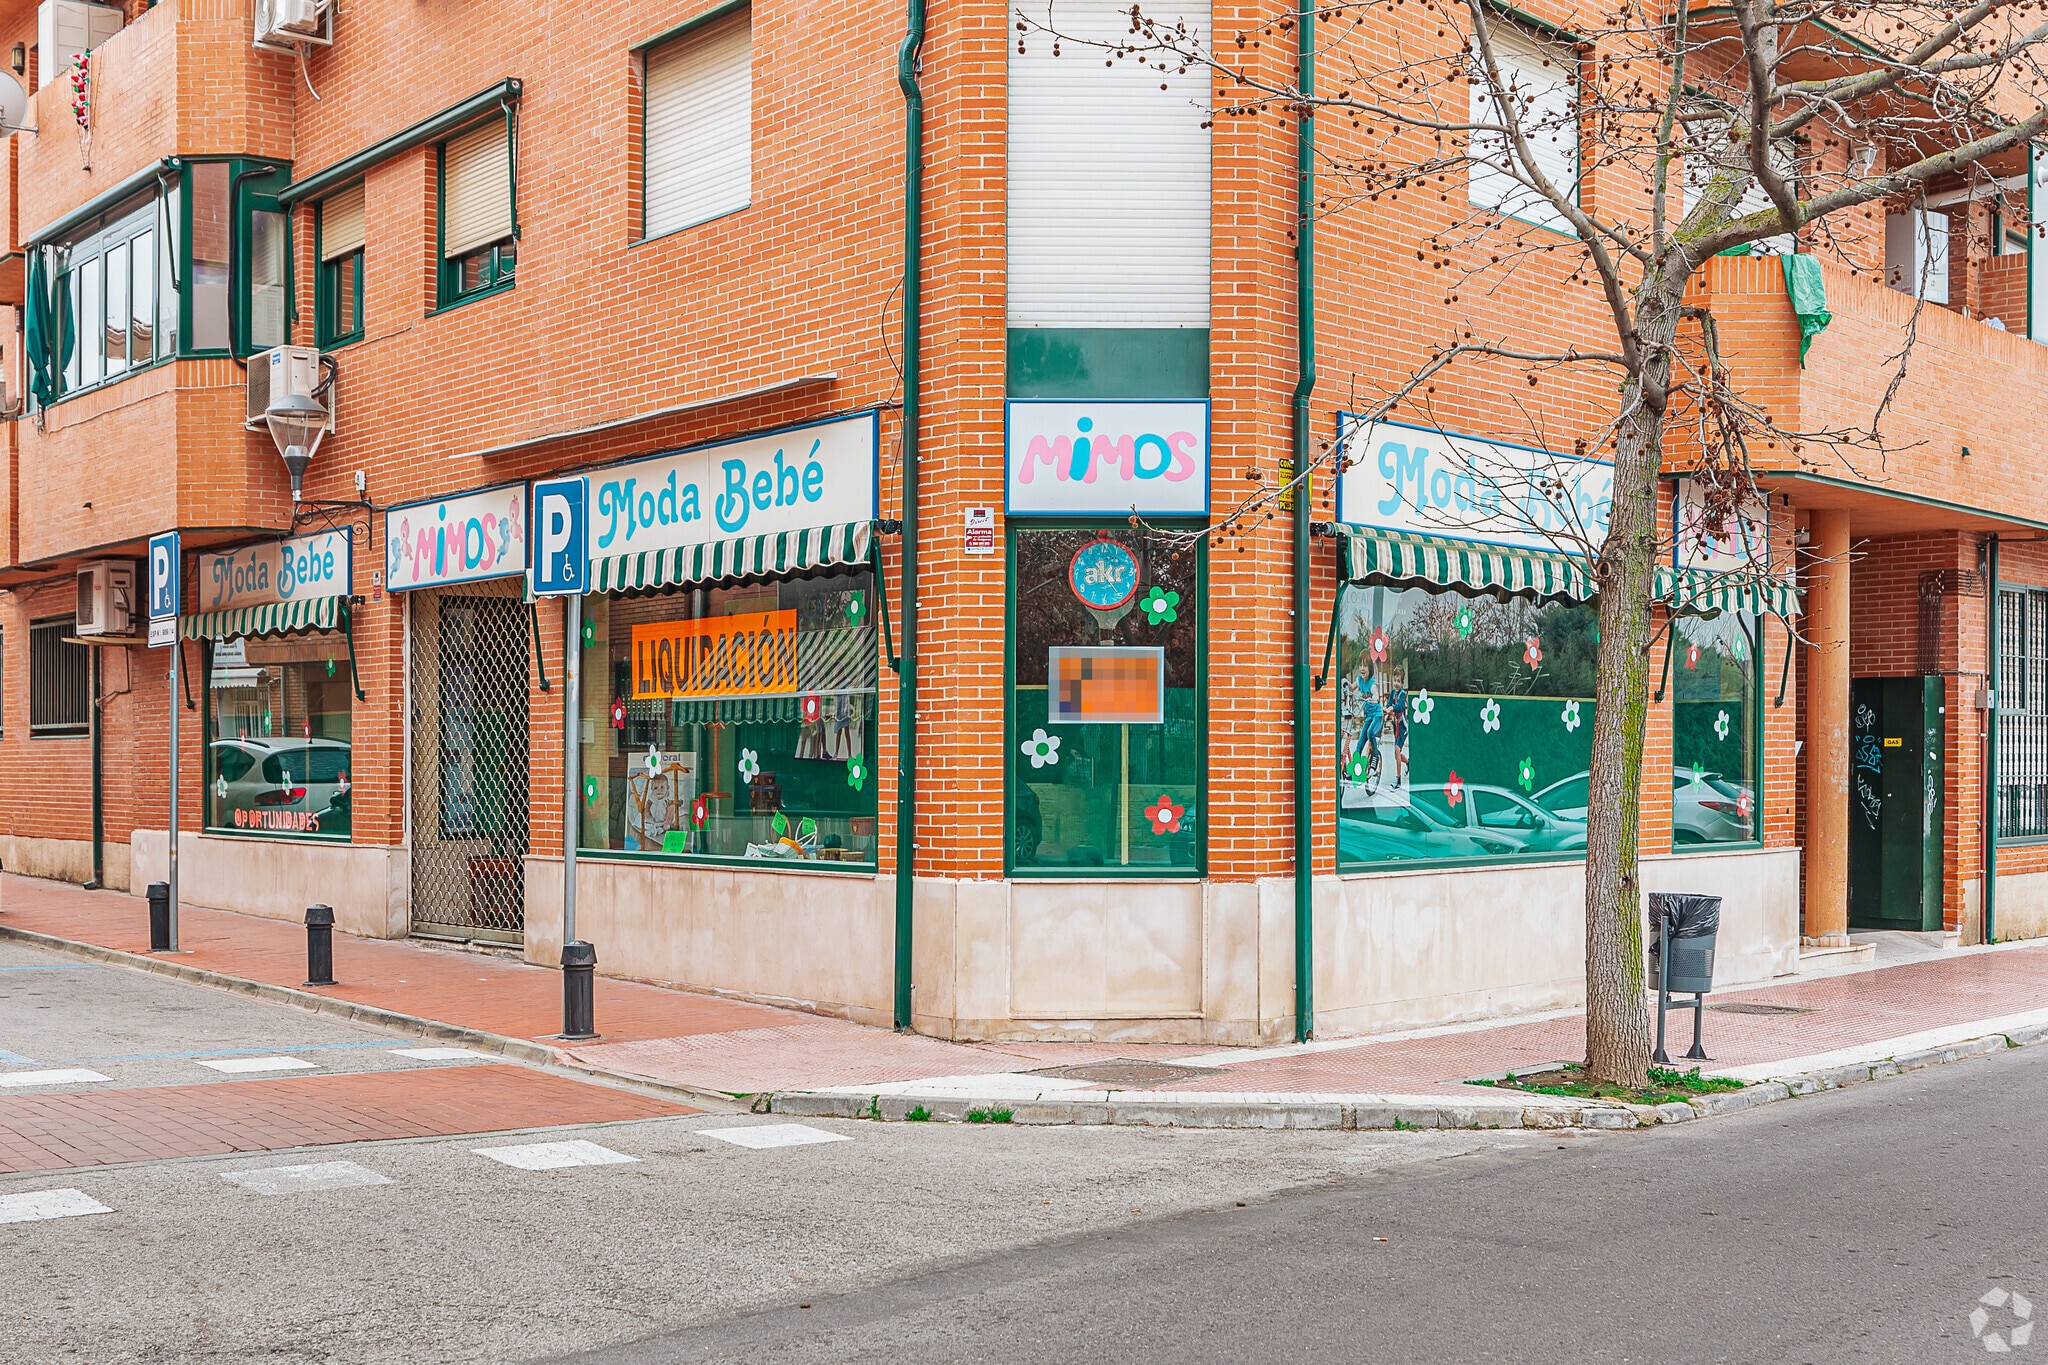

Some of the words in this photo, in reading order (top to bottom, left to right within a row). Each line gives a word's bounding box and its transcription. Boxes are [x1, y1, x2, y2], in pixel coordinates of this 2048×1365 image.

[597, 469, 701, 549] Moda
[715, 438, 824, 533] Bebé
[1377, 441, 1500, 517] Moda
[212, 551, 269, 607] Moda
[276, 535, 335, 599] Bebé
[541, 494, 572, 582] P
[1085, 559, 1125, 584] akr
[153, 545, 170, 610] P
[638, 615, 794, 695] LIQUIDACIÓN
[234, 808, 320, 831] OPORTUNIDADES
